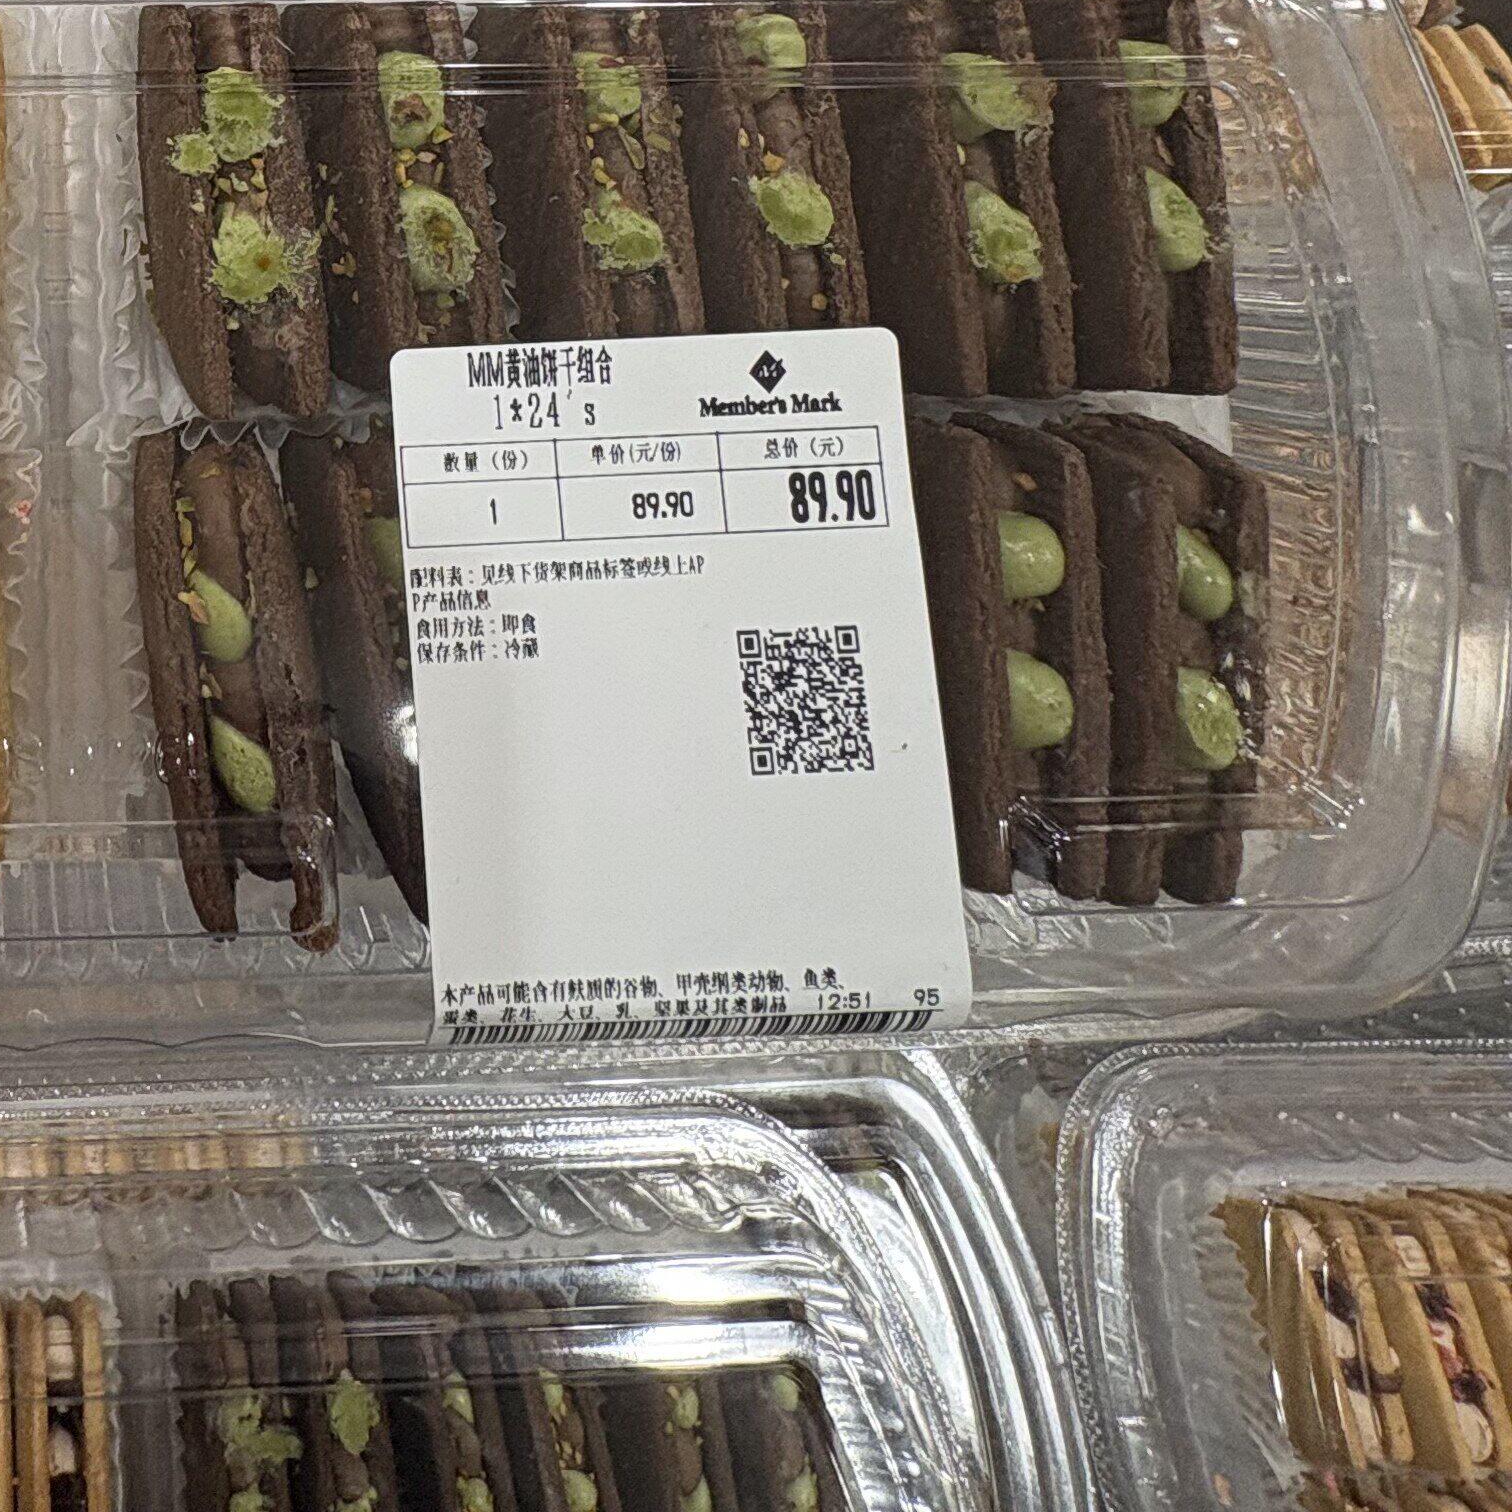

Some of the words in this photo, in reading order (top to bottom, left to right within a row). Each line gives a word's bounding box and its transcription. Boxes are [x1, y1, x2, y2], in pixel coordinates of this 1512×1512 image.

[467, 345, 613, 388] MM黄油饼干组合
[698, 395, 787, 417] Member's
[790, 391, 843, 413] Mark
[631, 491, 694, 520] 89.90
[789, 469, 876, 523] 89.90
[489, 497, 497, 525] 1
[817, 991, 871, 1011] 12:51
[913, 988, 939, 1007] 95
